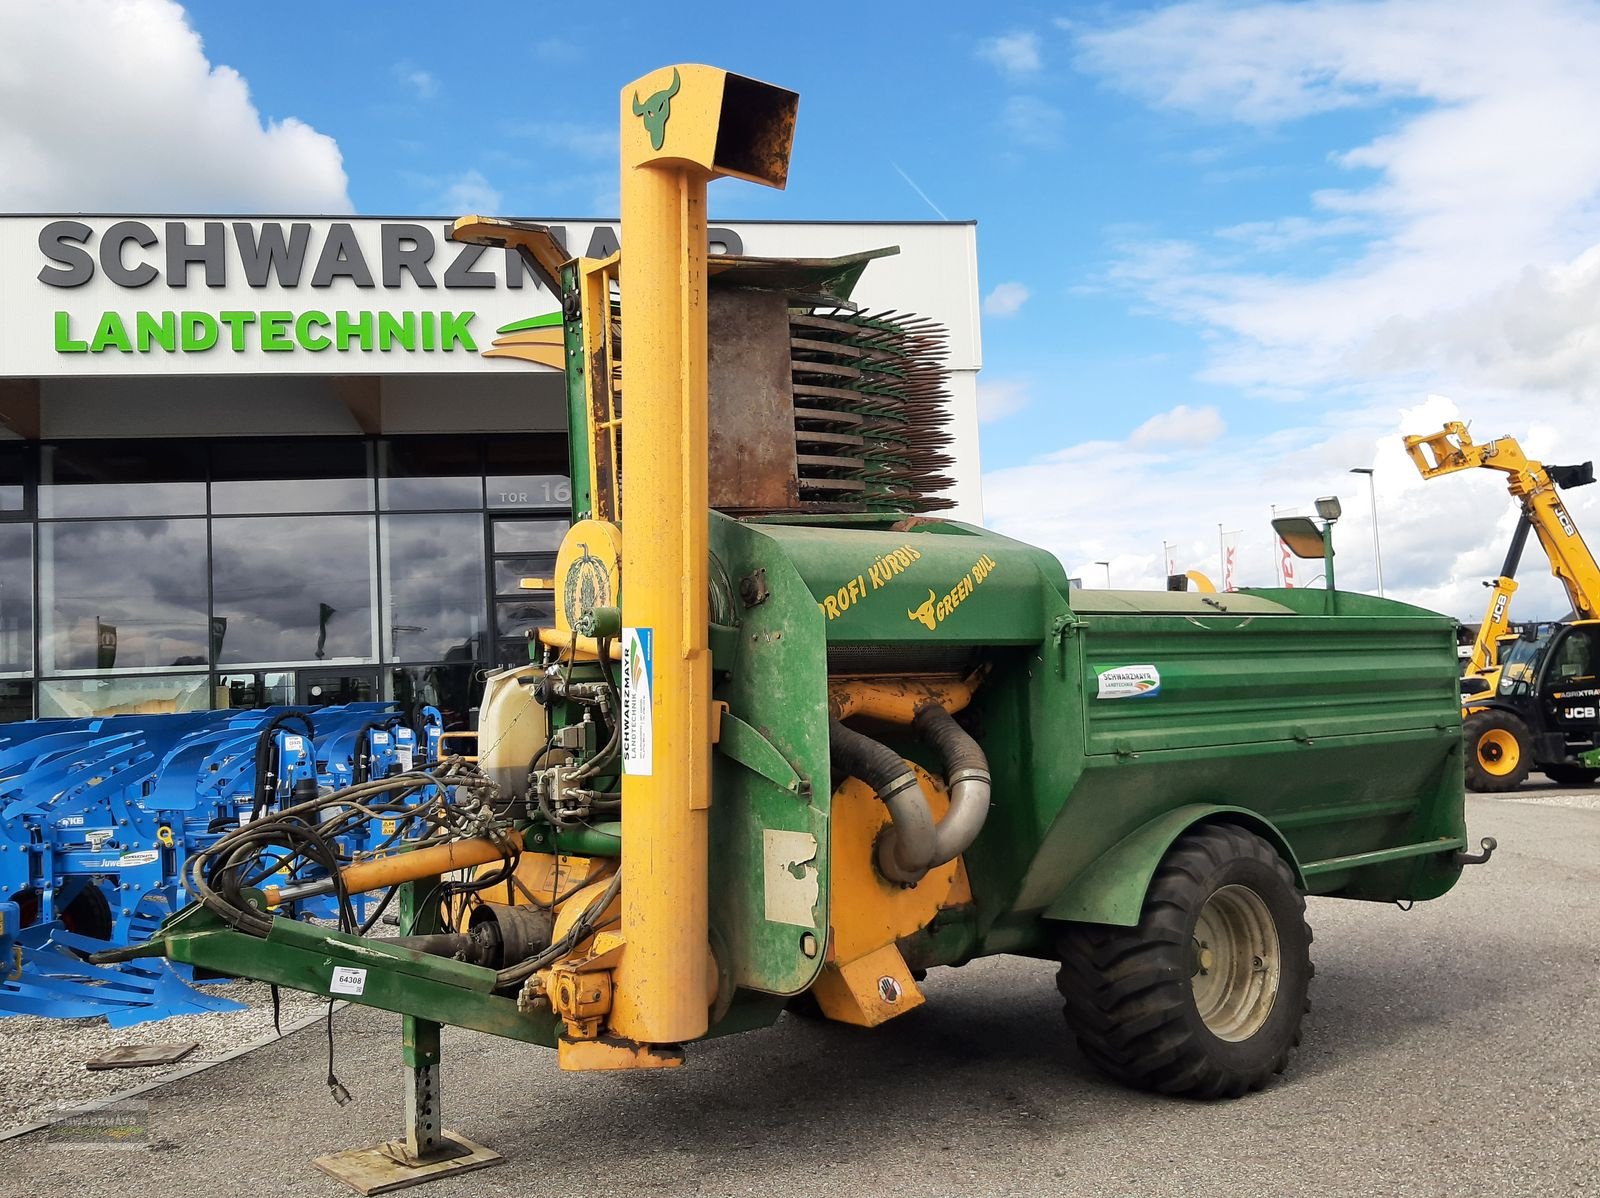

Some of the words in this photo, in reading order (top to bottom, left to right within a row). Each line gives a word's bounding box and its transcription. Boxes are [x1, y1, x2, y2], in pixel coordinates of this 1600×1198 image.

[55, 310, 478, 352] LANDTECHNIK
[500, 492, 528, 502] TOR
[541, 481, 571, 502] 16
[1555, 508, 1574, 537] JCB
[868, 544, 922, 590] KÜRBIS
[935, 574, 974, 622] GREEN
[971, 553, 996, 585] BULL
[1491, 594, 1508, 624] JCB
[1103, 672, 1151, 681] SCHWARZMAYR
[1565, 707, 1595, 719] JCB
[339, 975, 362, 985] 64308
